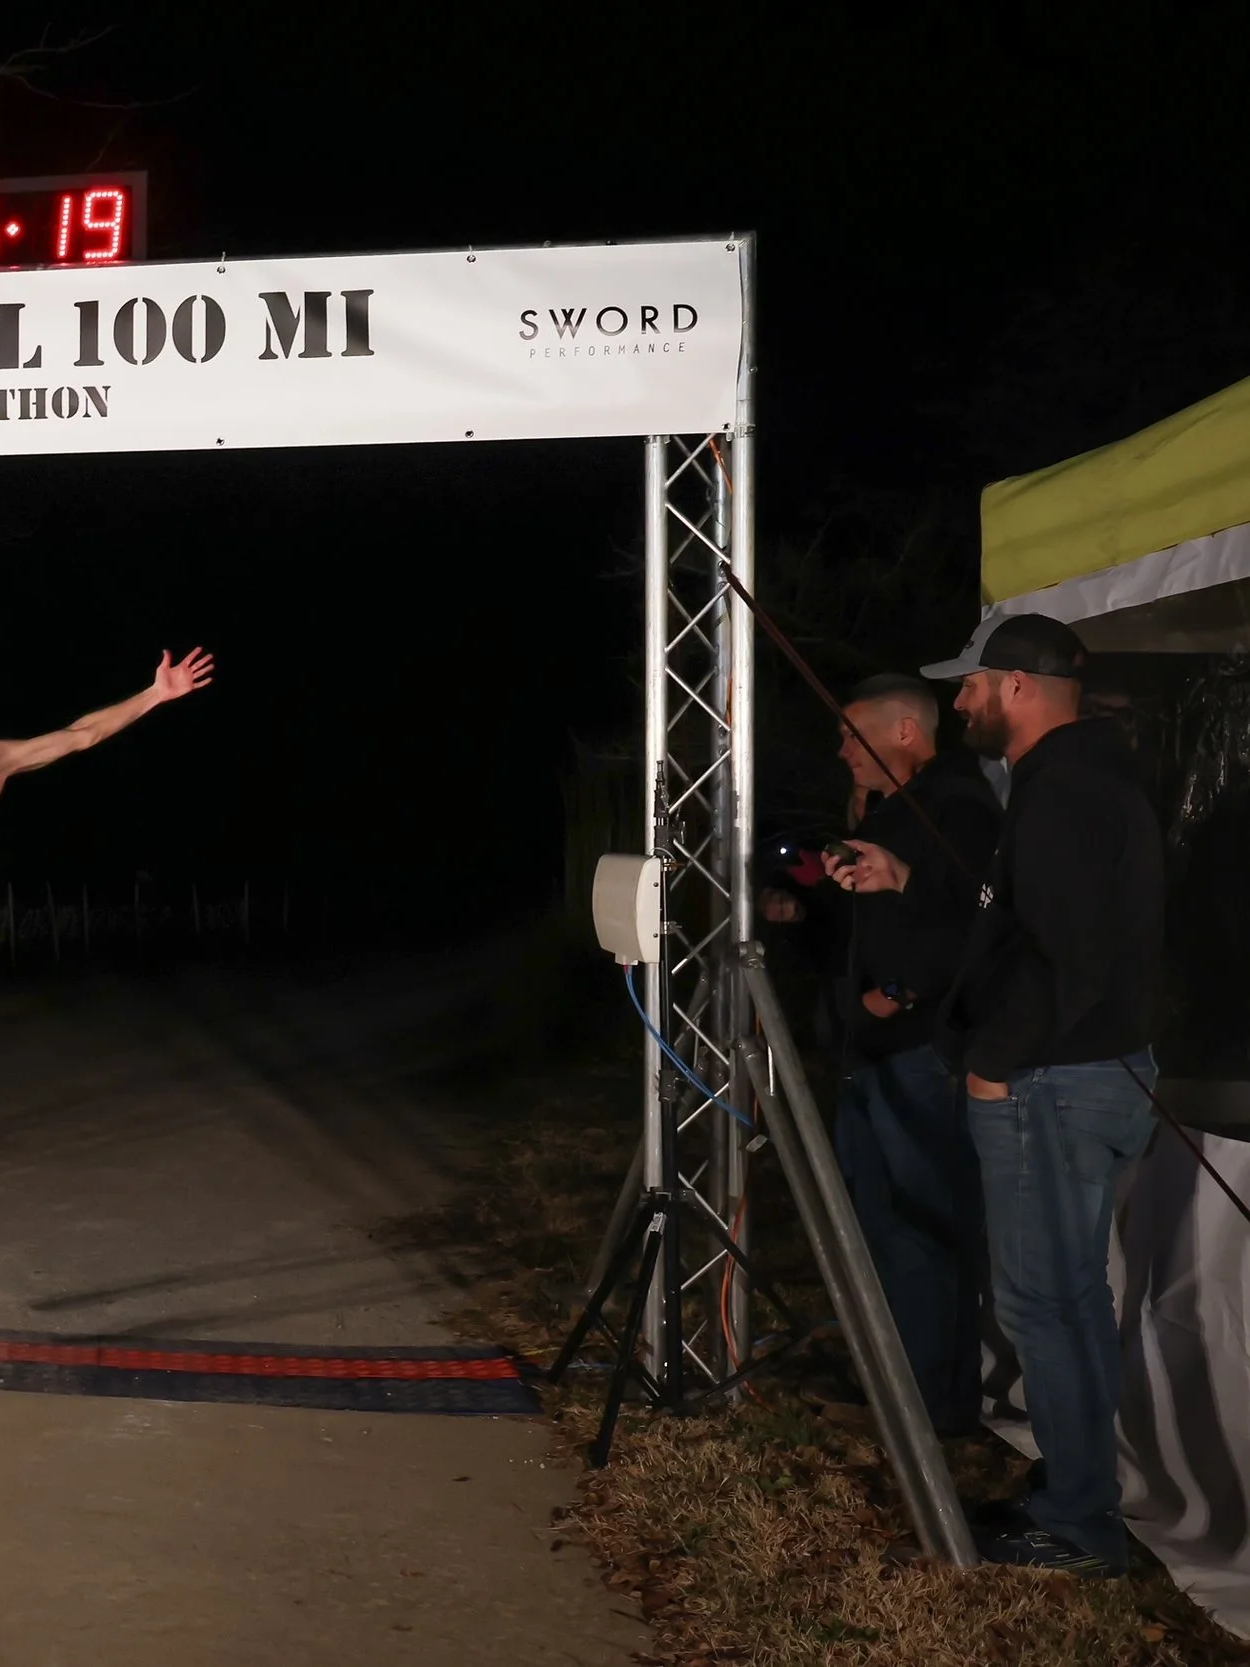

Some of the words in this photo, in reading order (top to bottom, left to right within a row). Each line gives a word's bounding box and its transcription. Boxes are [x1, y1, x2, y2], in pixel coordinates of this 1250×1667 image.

[73, 294, 227, 367] 100
[258, 288, 375, 360] MI
[519, 304, 698, 341] SWORD
[530, 342, 685, 359] PERFORMANCE
